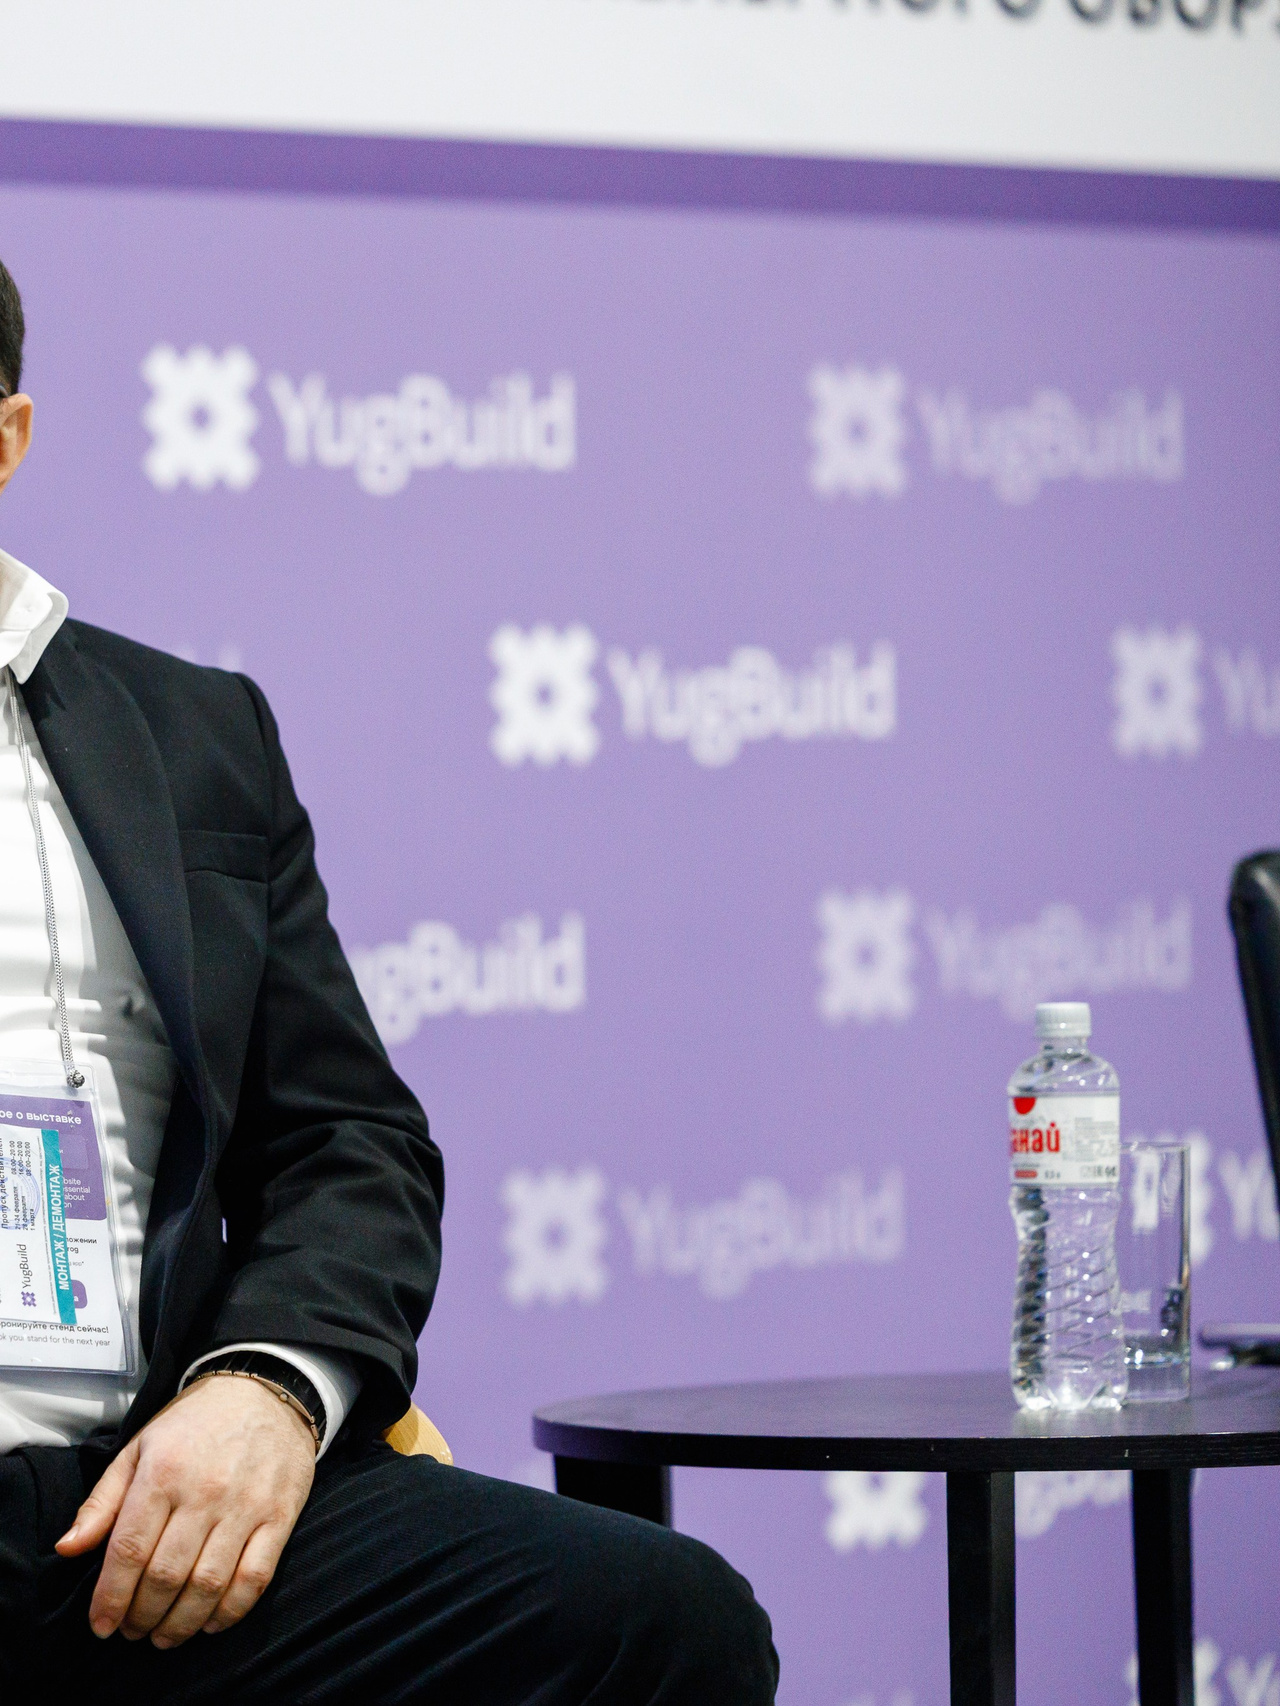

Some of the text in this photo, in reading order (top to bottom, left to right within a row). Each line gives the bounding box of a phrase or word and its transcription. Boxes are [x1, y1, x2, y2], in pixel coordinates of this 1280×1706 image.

[268, 370, 577, 495] YugBuild
[607, 640, 897, 767] YugBuild
[15, 1111, 24, 1120] о
[26, 1112, 82, 1125] выставке
[0, 1195, 10, 1230] Пропуск
[48, 1163, 65, 1233] ДЕМОНТАЖ
[16, 1243, 33, 1289] YugBuild
[51, 1240, 70, 1291] МОНТАЖ
[26, 1335, 48, 1343] stand
[49, 1335, 60, 1344] for
[62, 1336, 75, 1345] the
[76, 1338, 93, 1346] next
[94, 1339, 111, 1347] year
[49, 1324, 76, 1333] стенд
[76, 1325, 110, 1334] сейчас!
